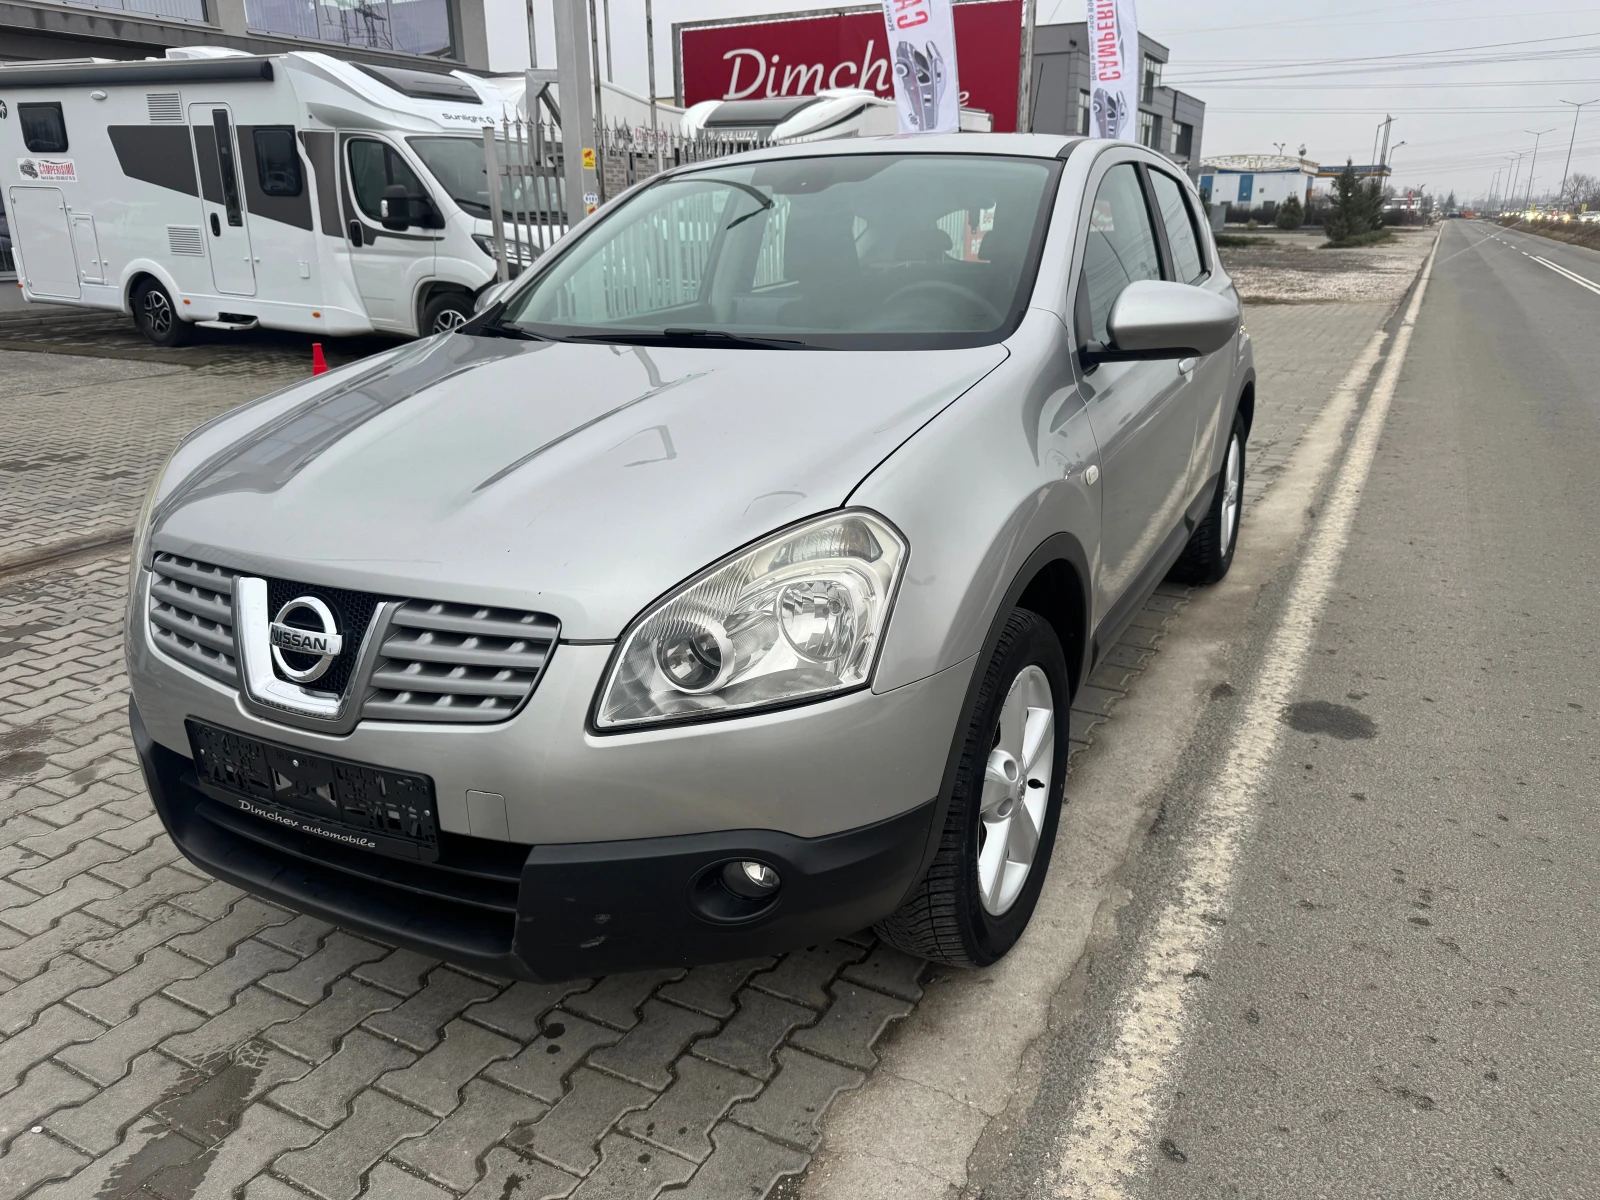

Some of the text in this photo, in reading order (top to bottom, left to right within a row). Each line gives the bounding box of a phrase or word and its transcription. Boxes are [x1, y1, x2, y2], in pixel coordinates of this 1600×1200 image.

[723, 39, 895, 99] Dimch
[442, 113, 487, 123] Sunlight
[271, 627, 327, 650] NISSAN
[239, 800, 376, 848] Dimchev automobile
